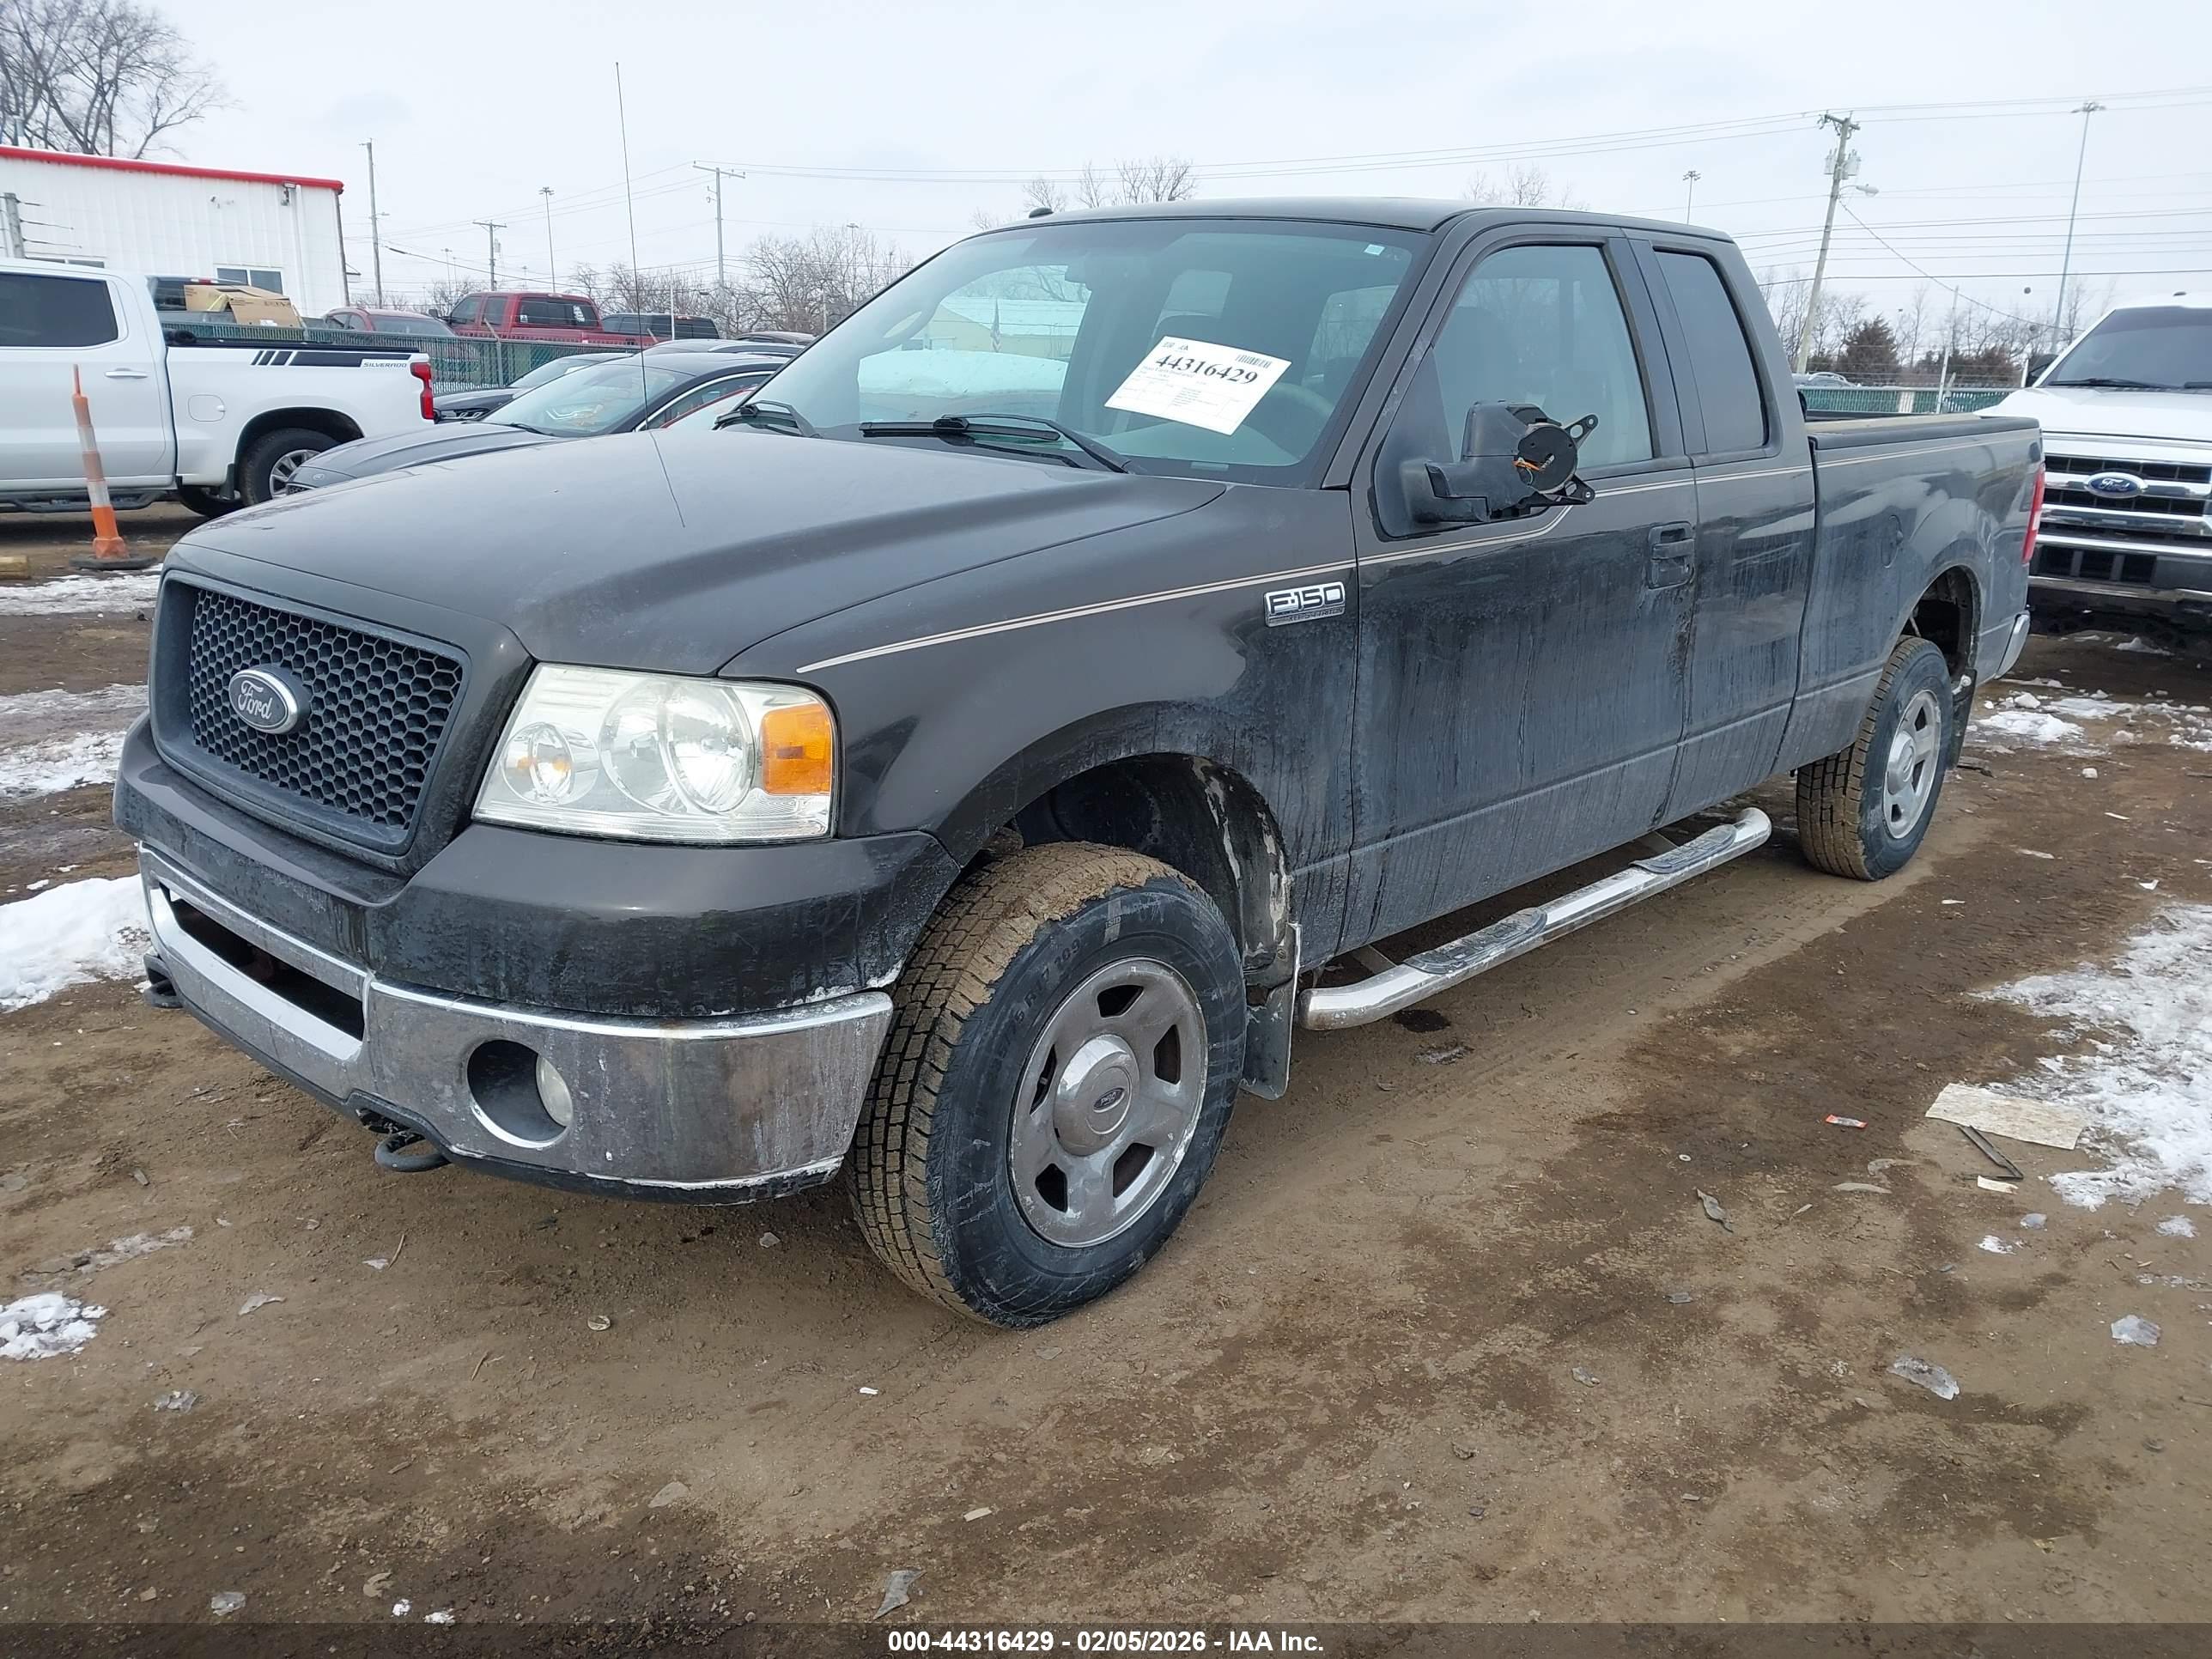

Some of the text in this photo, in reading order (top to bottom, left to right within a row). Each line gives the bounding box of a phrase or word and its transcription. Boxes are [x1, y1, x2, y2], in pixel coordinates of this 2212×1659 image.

[1156, 355, 1258, 385] 44316429
[2100, 477, 2130, 492] Ford
[237, 679, 273, 720] Ford
